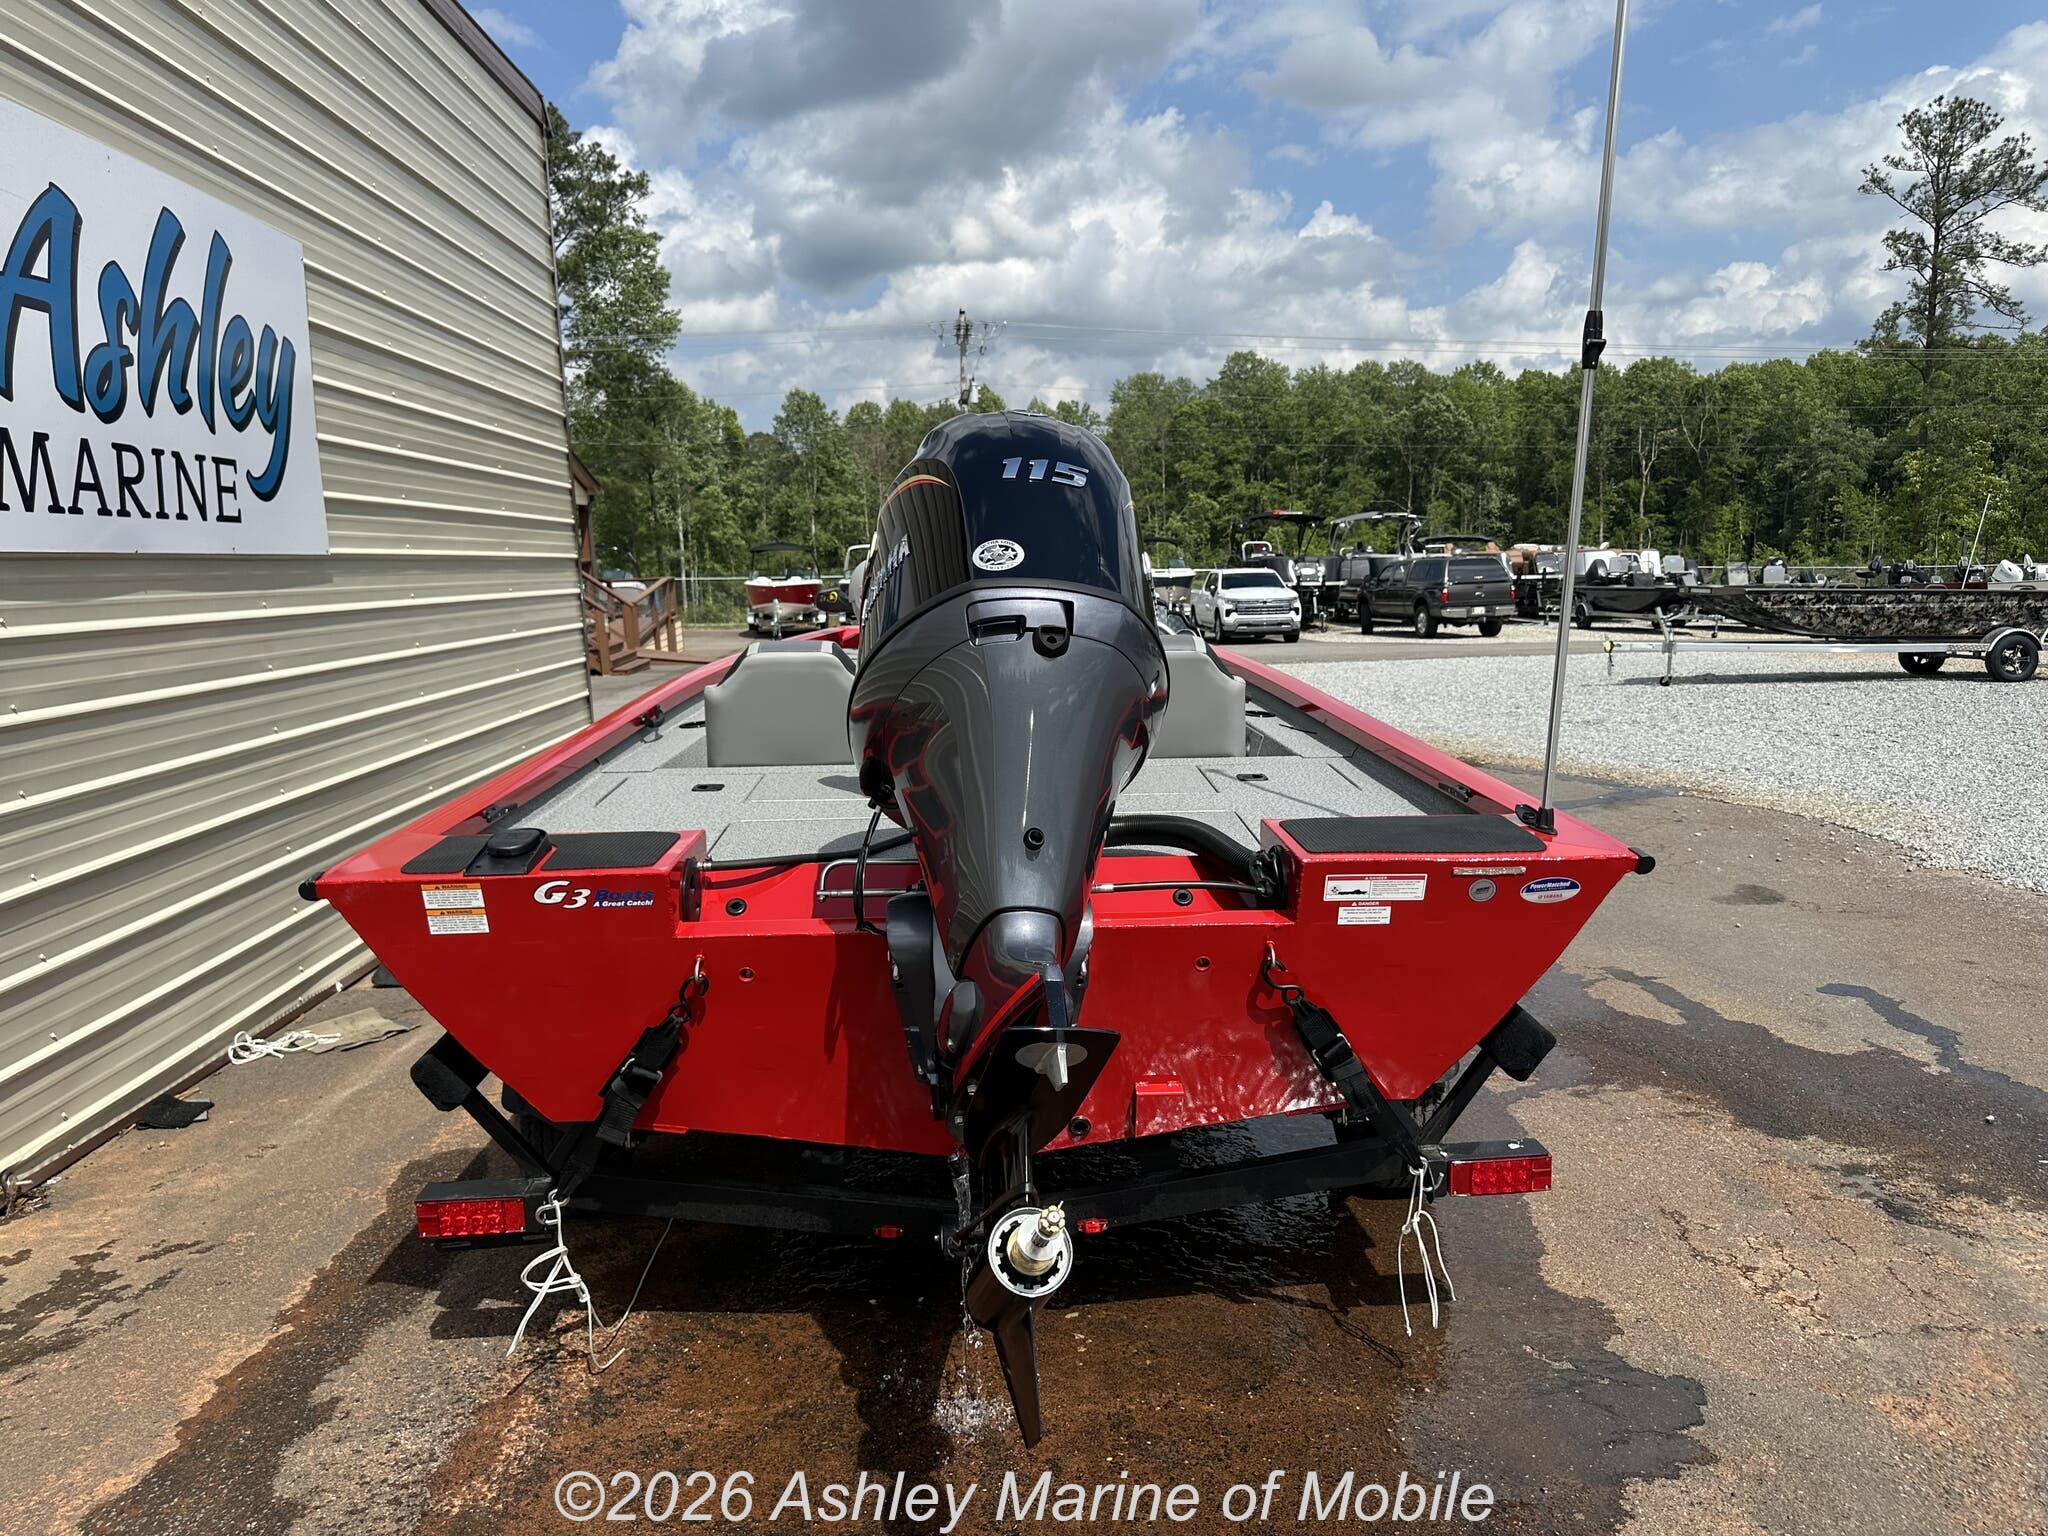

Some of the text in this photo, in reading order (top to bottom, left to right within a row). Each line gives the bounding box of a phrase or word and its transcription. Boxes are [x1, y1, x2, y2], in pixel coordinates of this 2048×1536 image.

[0, 181, 296, 502] Ashley
[0, 427, 242, 523] MARINE
[1001, 456, 1090, 488] 115
[533, 880, 654, 909] G3 Boats
